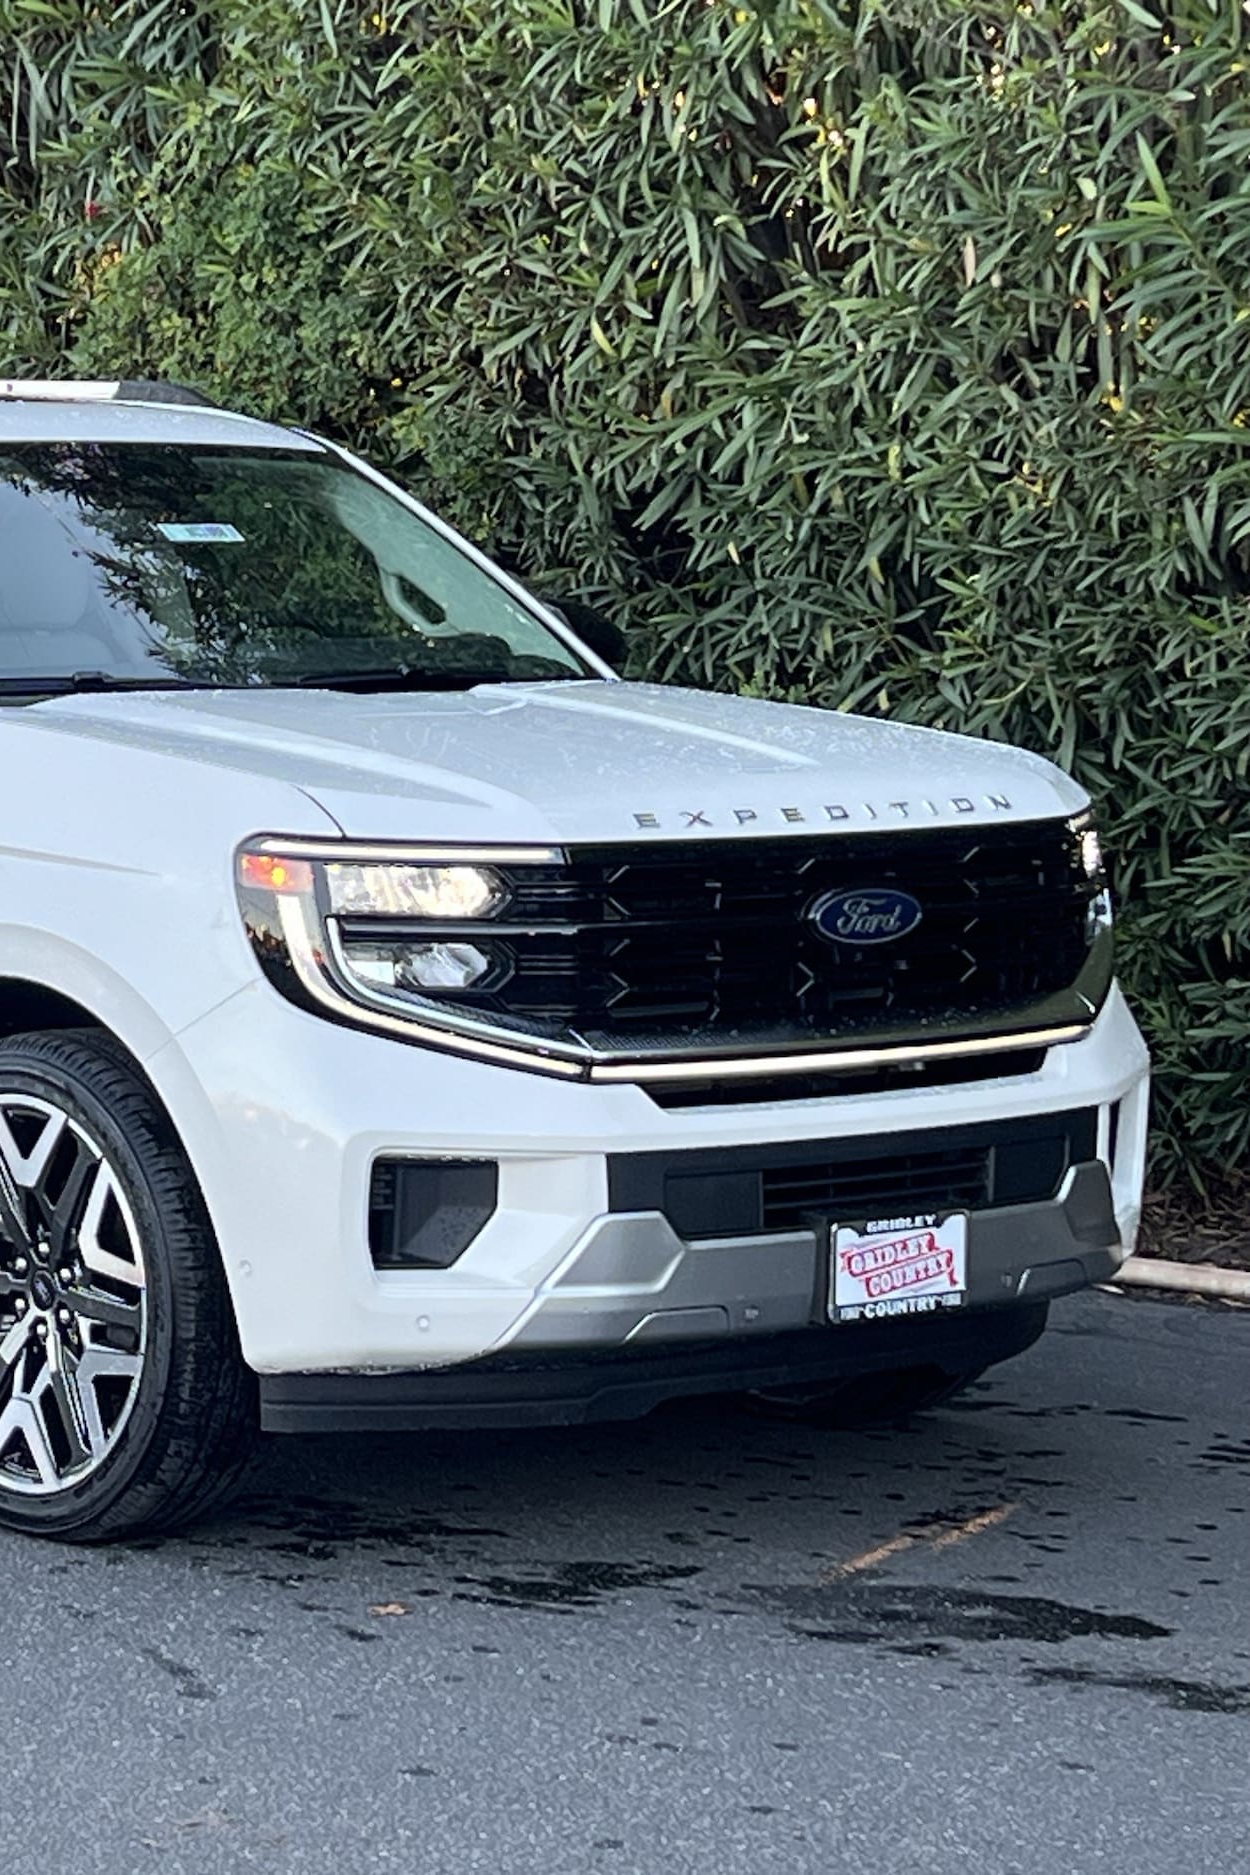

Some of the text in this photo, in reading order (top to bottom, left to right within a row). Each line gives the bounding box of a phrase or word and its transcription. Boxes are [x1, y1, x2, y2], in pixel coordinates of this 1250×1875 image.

[632, 794, 1013, 829] EXPEDITION
[836, 896, 902, 935] Ford
[866, 1213, 937, 1233] GRIDLEY
[851, 1234, 932, 1274] GRIDLEY
[868, 1254, 948, 1297] COUNTRY
[864, 1294, 936, 1319] COUNTRY
